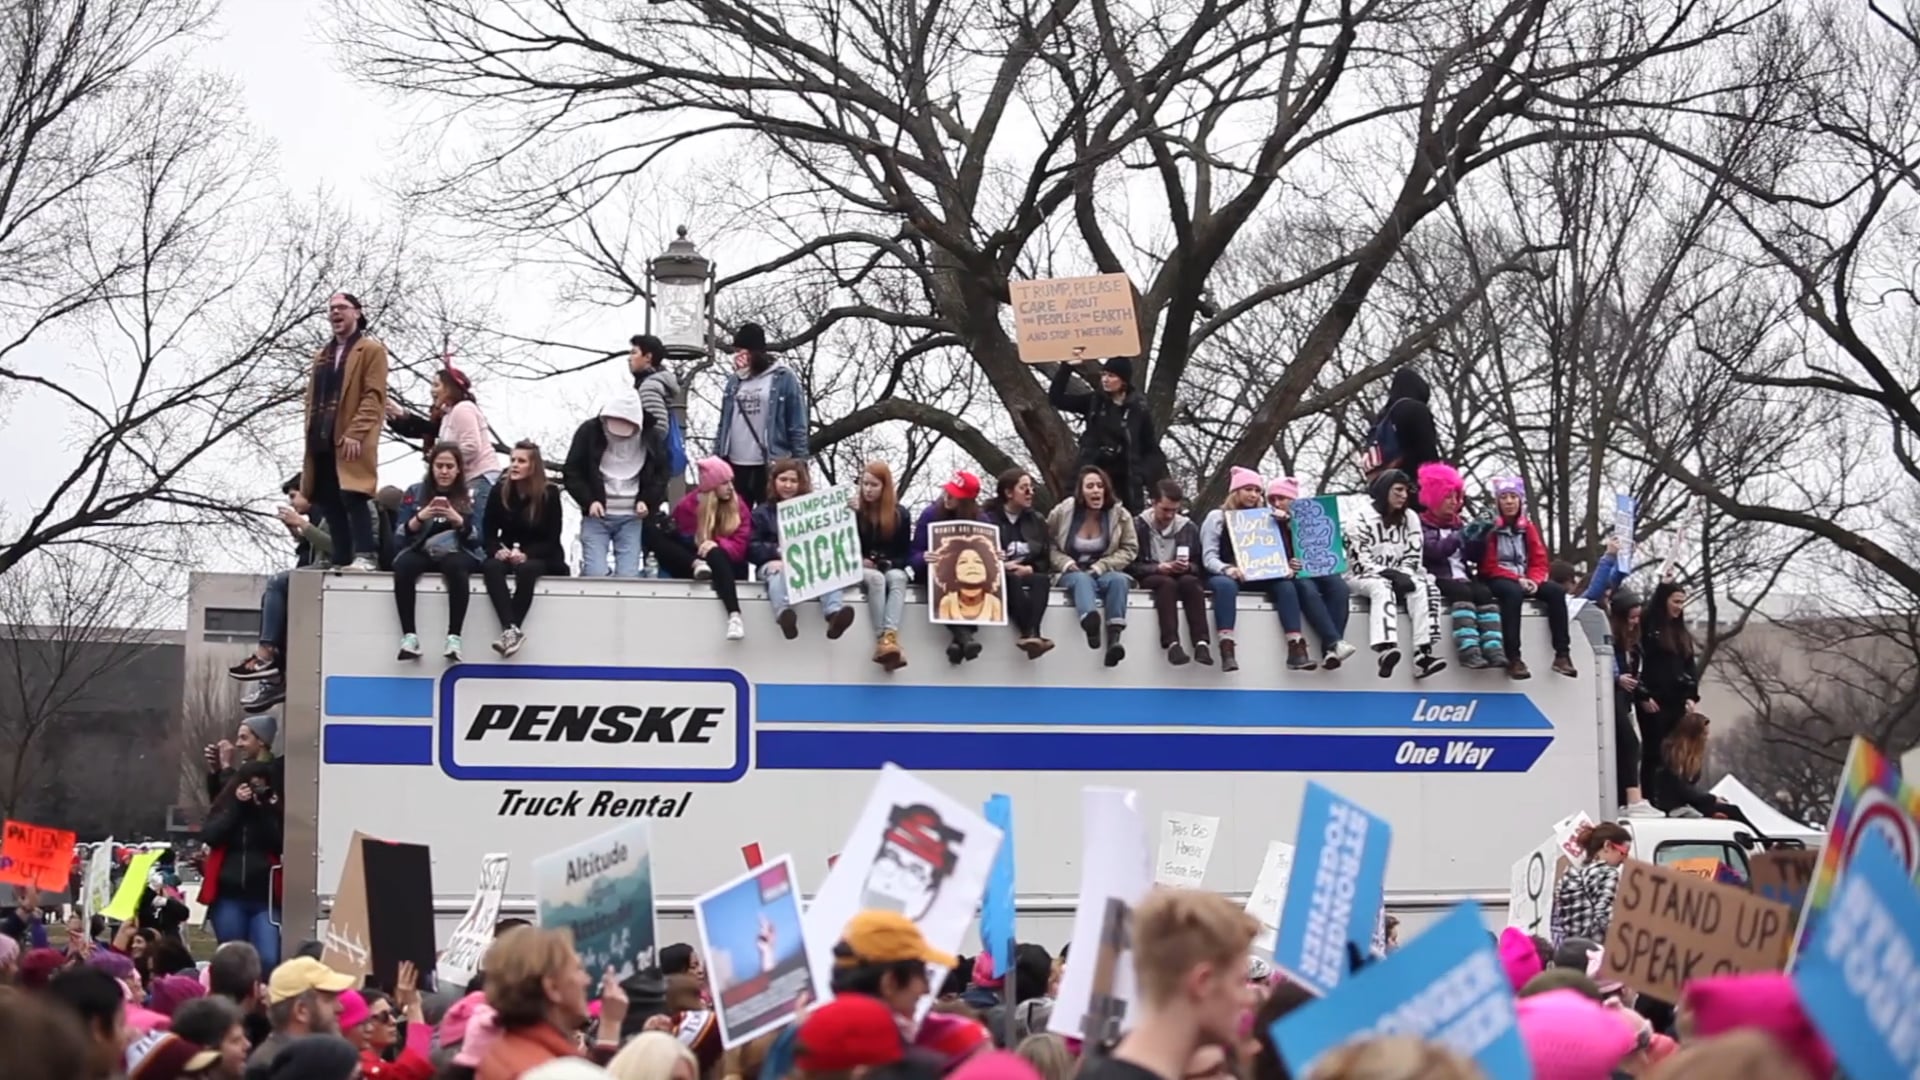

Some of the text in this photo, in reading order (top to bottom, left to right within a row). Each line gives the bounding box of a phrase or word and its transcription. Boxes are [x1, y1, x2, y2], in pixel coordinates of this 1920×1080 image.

[1074, 279, 1122, 297] PLEASE
[1019, 296, 1099, 315] CARE ABOUT
[1092, 307, 1133, 324] EARTH
[1026, 326, 1124, 342] AND STOP TWEETING
[779, 487, 852, 521] TRUMPCARE
[783, 505, 852, 540] MAKES US
[786, 525, 859, 592] SICK!
[464, 704, 726, 744] PENSKE
[1411, 698, 1478, 722] Local
[1394, 740, 1495, 770] One Way
[497, 788, 694, 818] Truck Rental
[566, 841, 629, 886] Altitude
[1299, 801, 1349, 978] TOGETHER
[1317, 808, 1369, 989] STRONGER
[1622, 868, 1722, 935] STAND
[1735, 904, 1779, 952] UP
[1610, 921, 1705, 988] SPEAK
